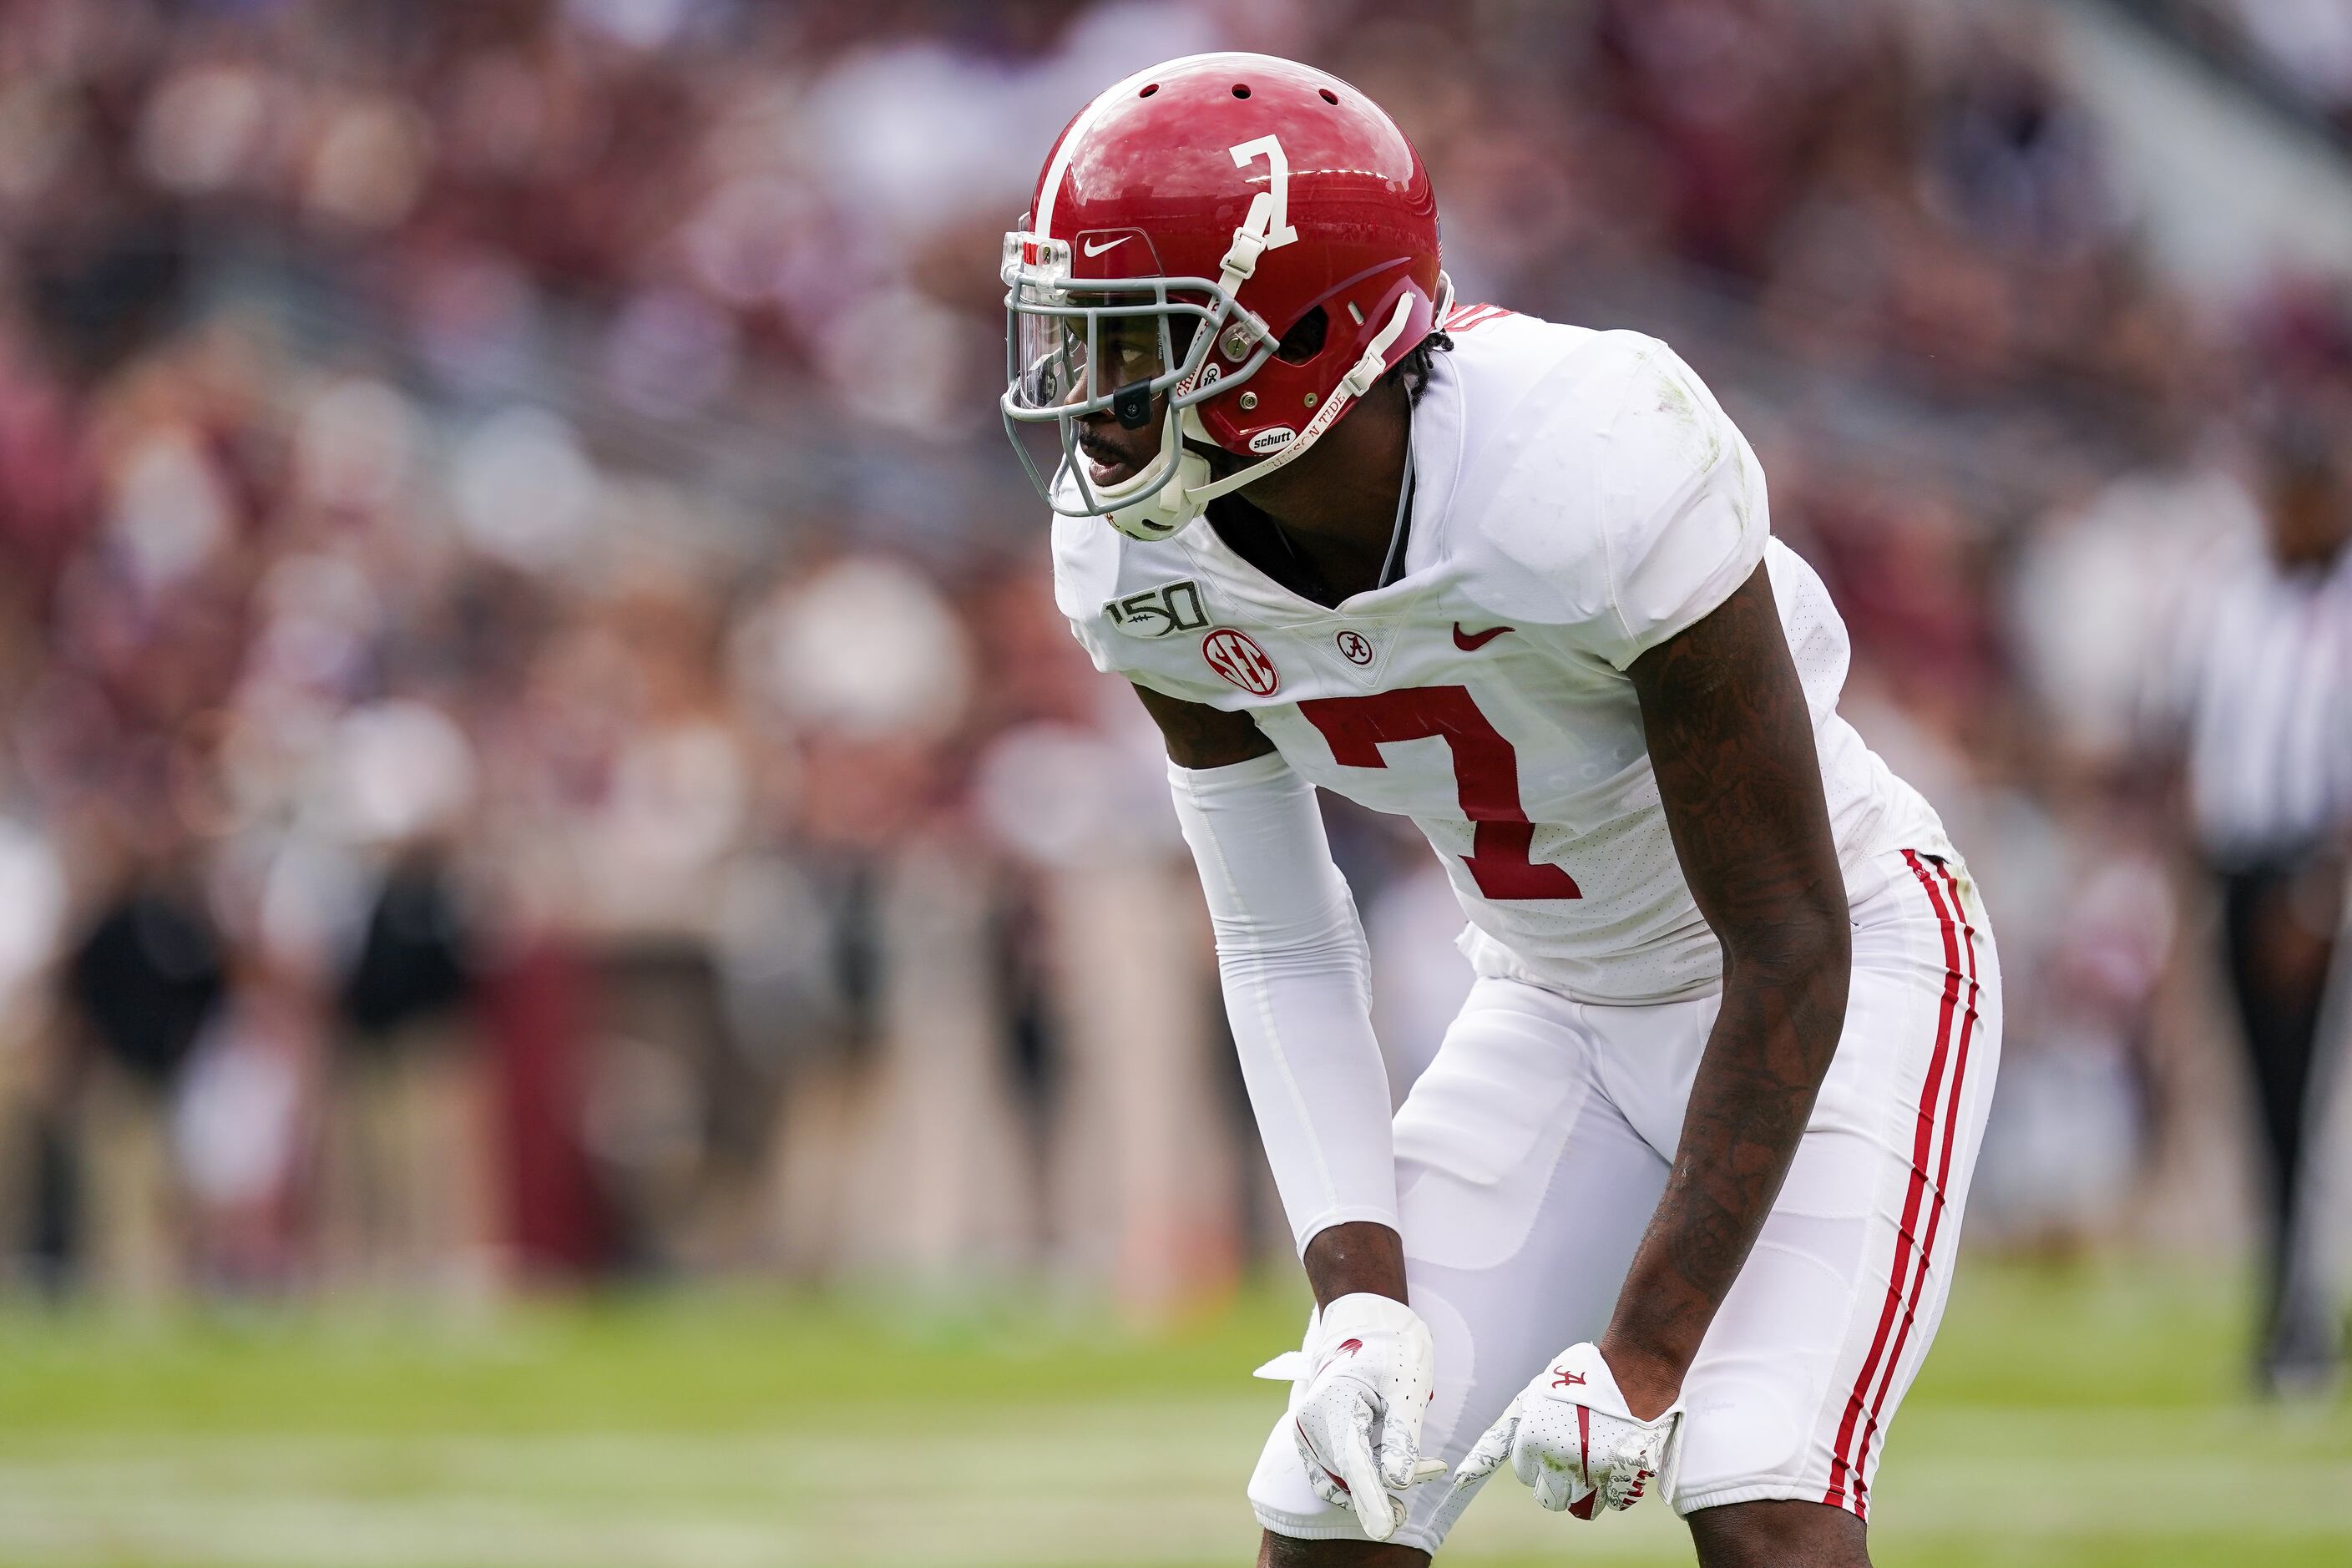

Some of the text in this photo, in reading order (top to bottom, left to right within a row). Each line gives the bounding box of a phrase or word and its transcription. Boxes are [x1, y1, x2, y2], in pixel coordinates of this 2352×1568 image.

[1229, 134, 1299, 250] 7
[1318, 392, 1346, 423] TIDE
[1253, 431, 1292, 449] schutt
[1105, 581, 1210, 636] 150
[1205, 632, 1278, 694] SEC
[1345, 634, 1368, 660] A
[1297, 685, 1583, 900] 7
